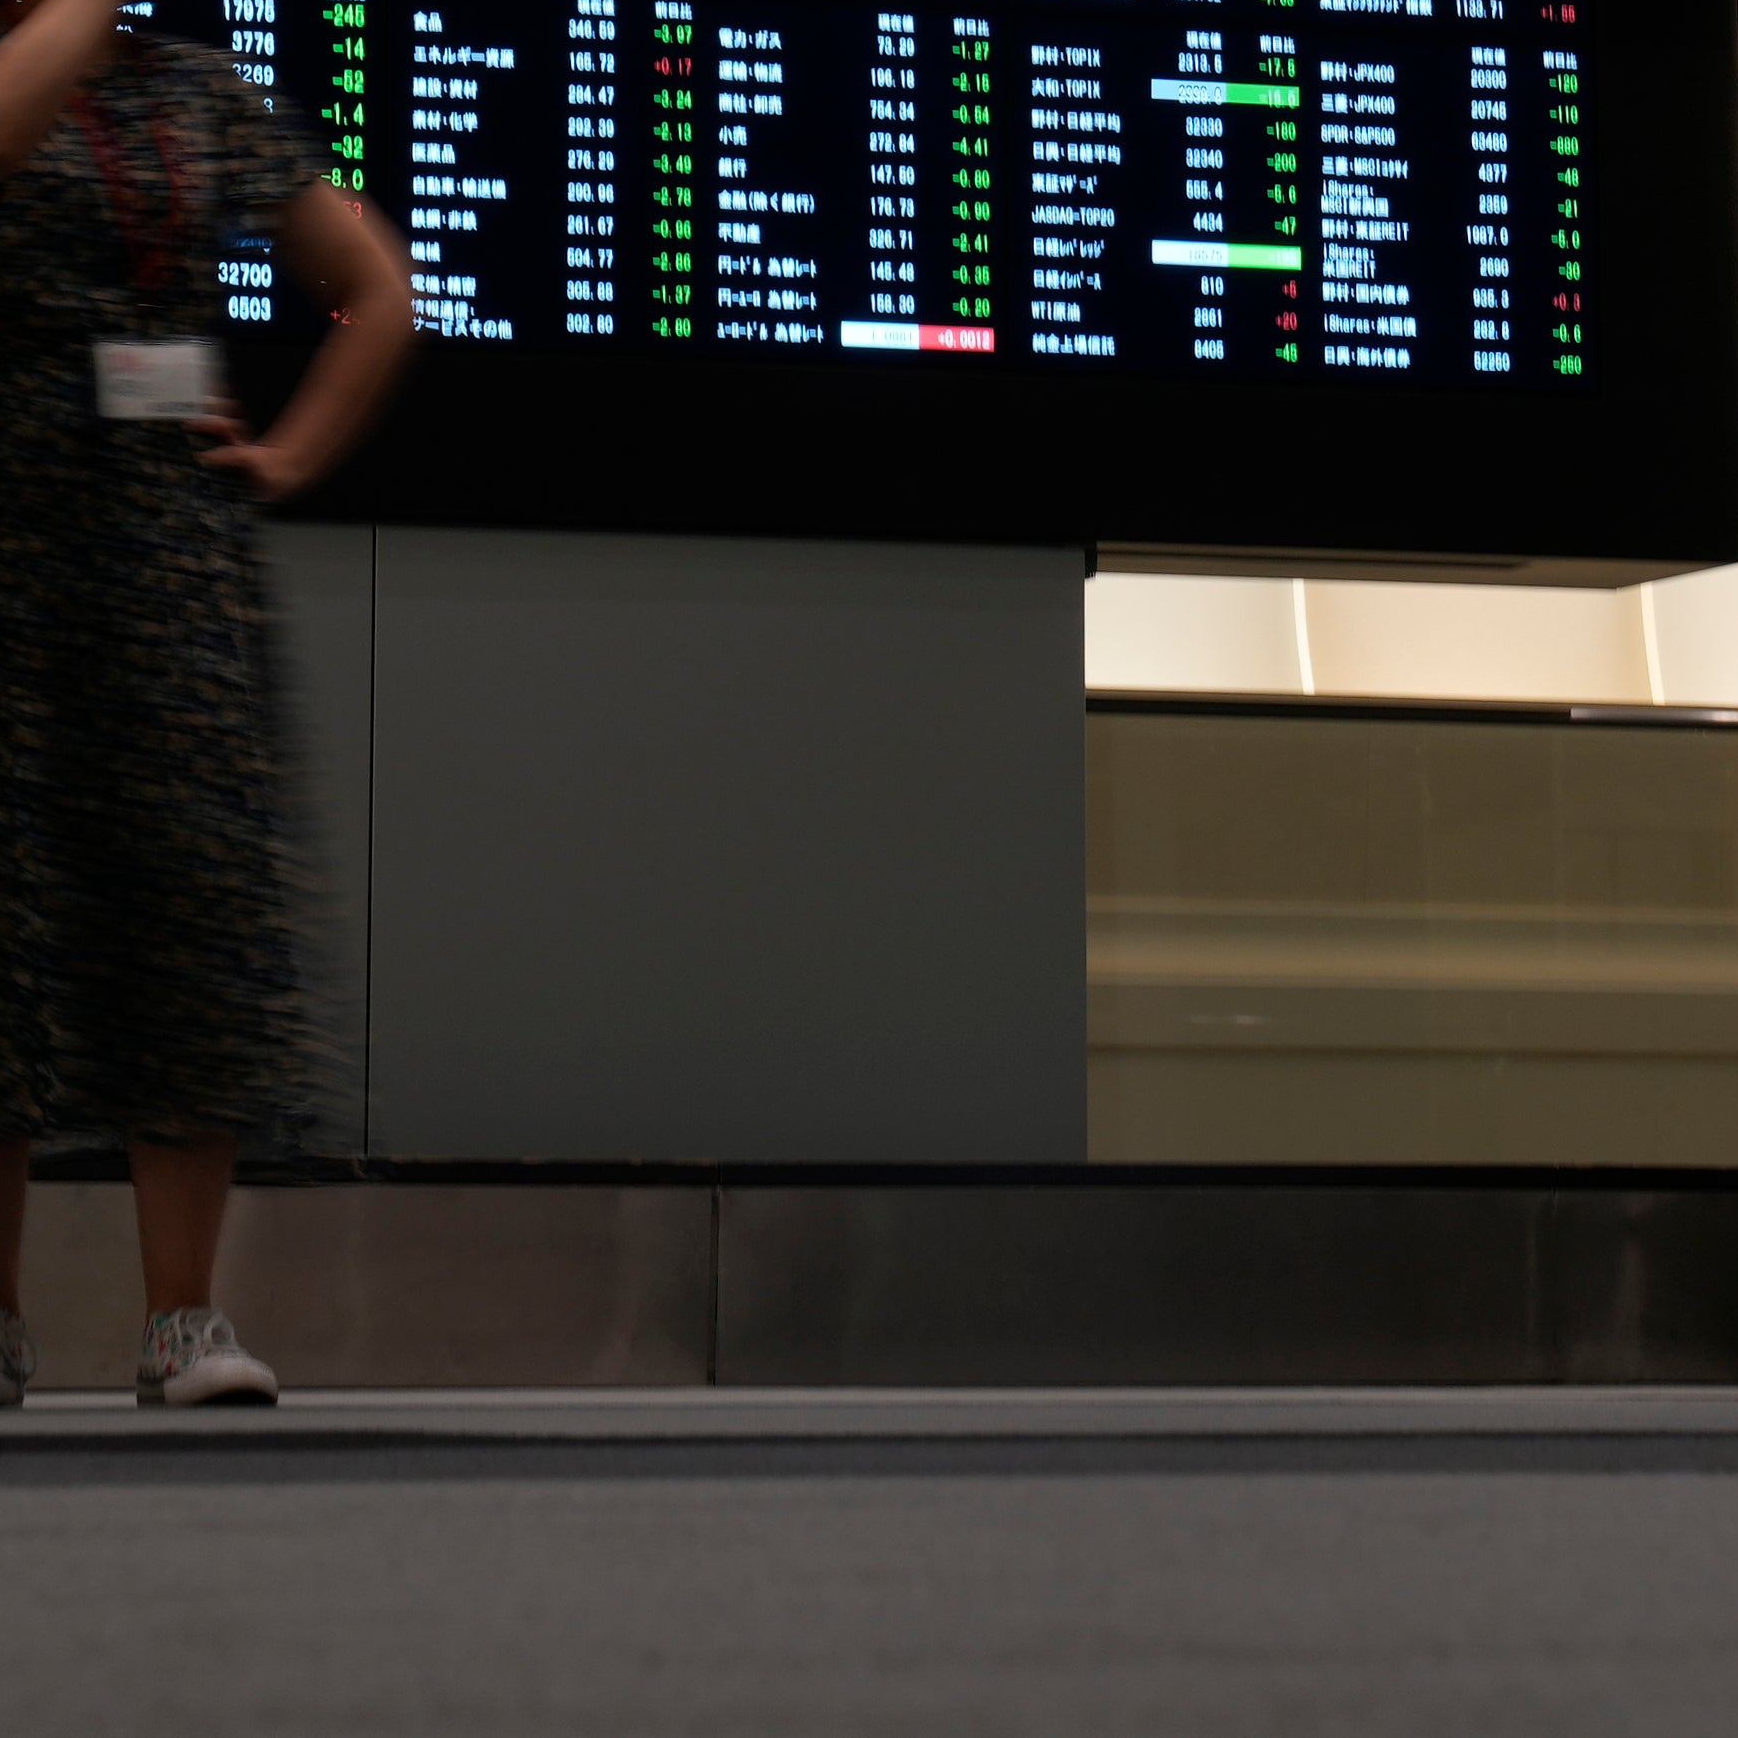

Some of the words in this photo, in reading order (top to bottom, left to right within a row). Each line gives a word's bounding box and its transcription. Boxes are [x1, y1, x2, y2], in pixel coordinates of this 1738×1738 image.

[413, 44, 514, 69] エネルギー資源
[217, 261, 273, 289] 32700
